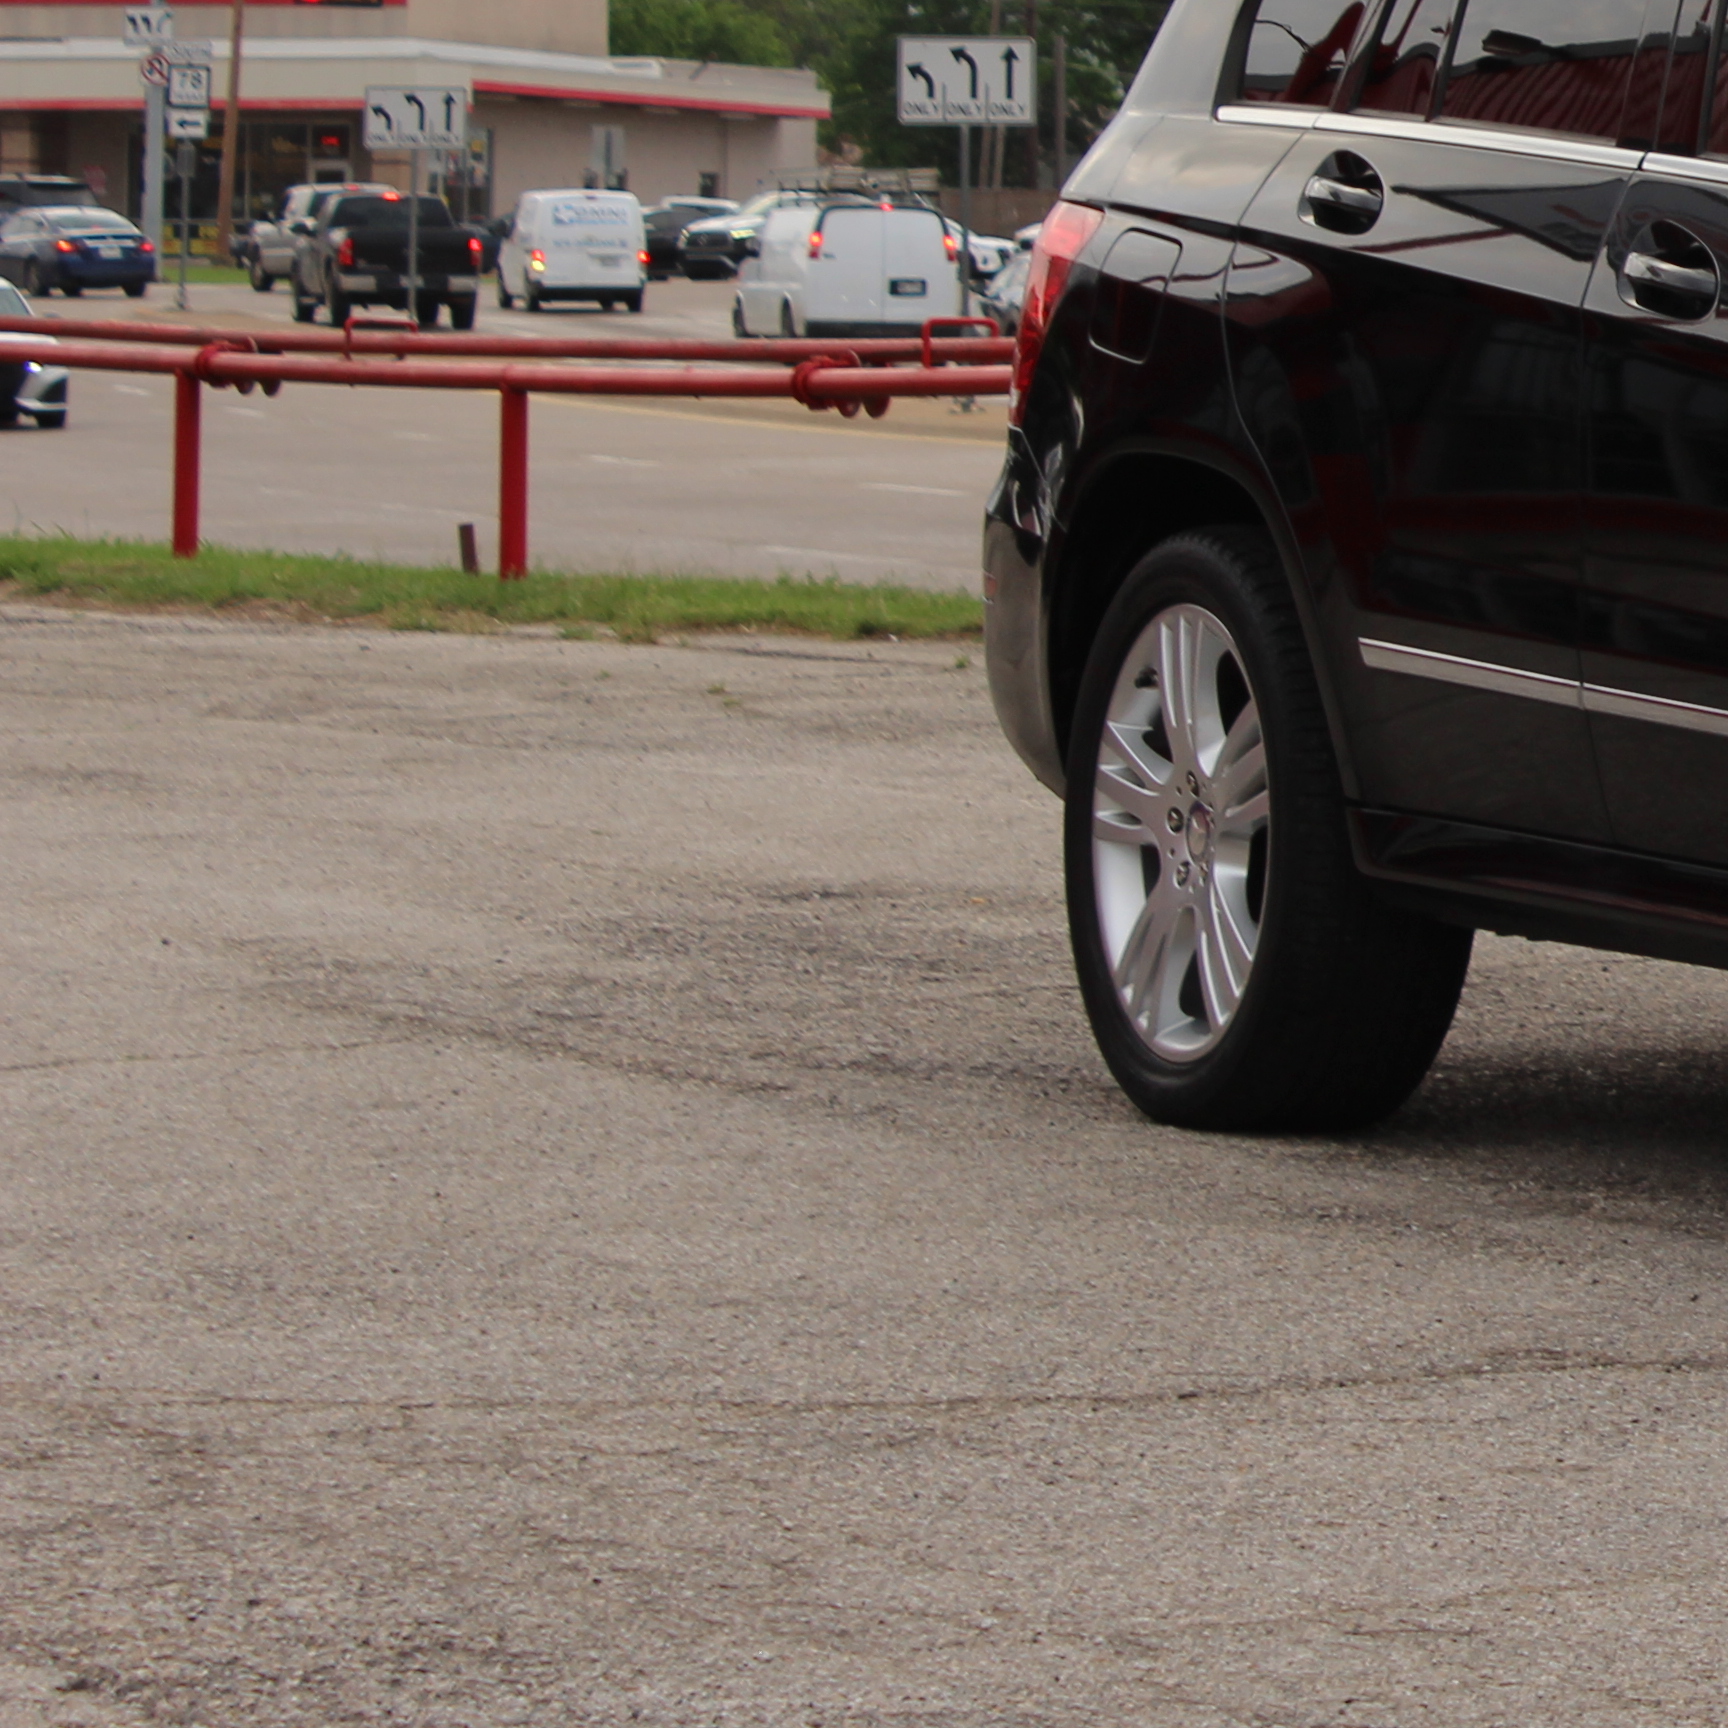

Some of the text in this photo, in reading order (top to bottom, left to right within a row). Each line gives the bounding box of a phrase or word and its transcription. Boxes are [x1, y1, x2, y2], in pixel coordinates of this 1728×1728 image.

[903, 101, 1026, 116] ONLY ONLY ONLY
